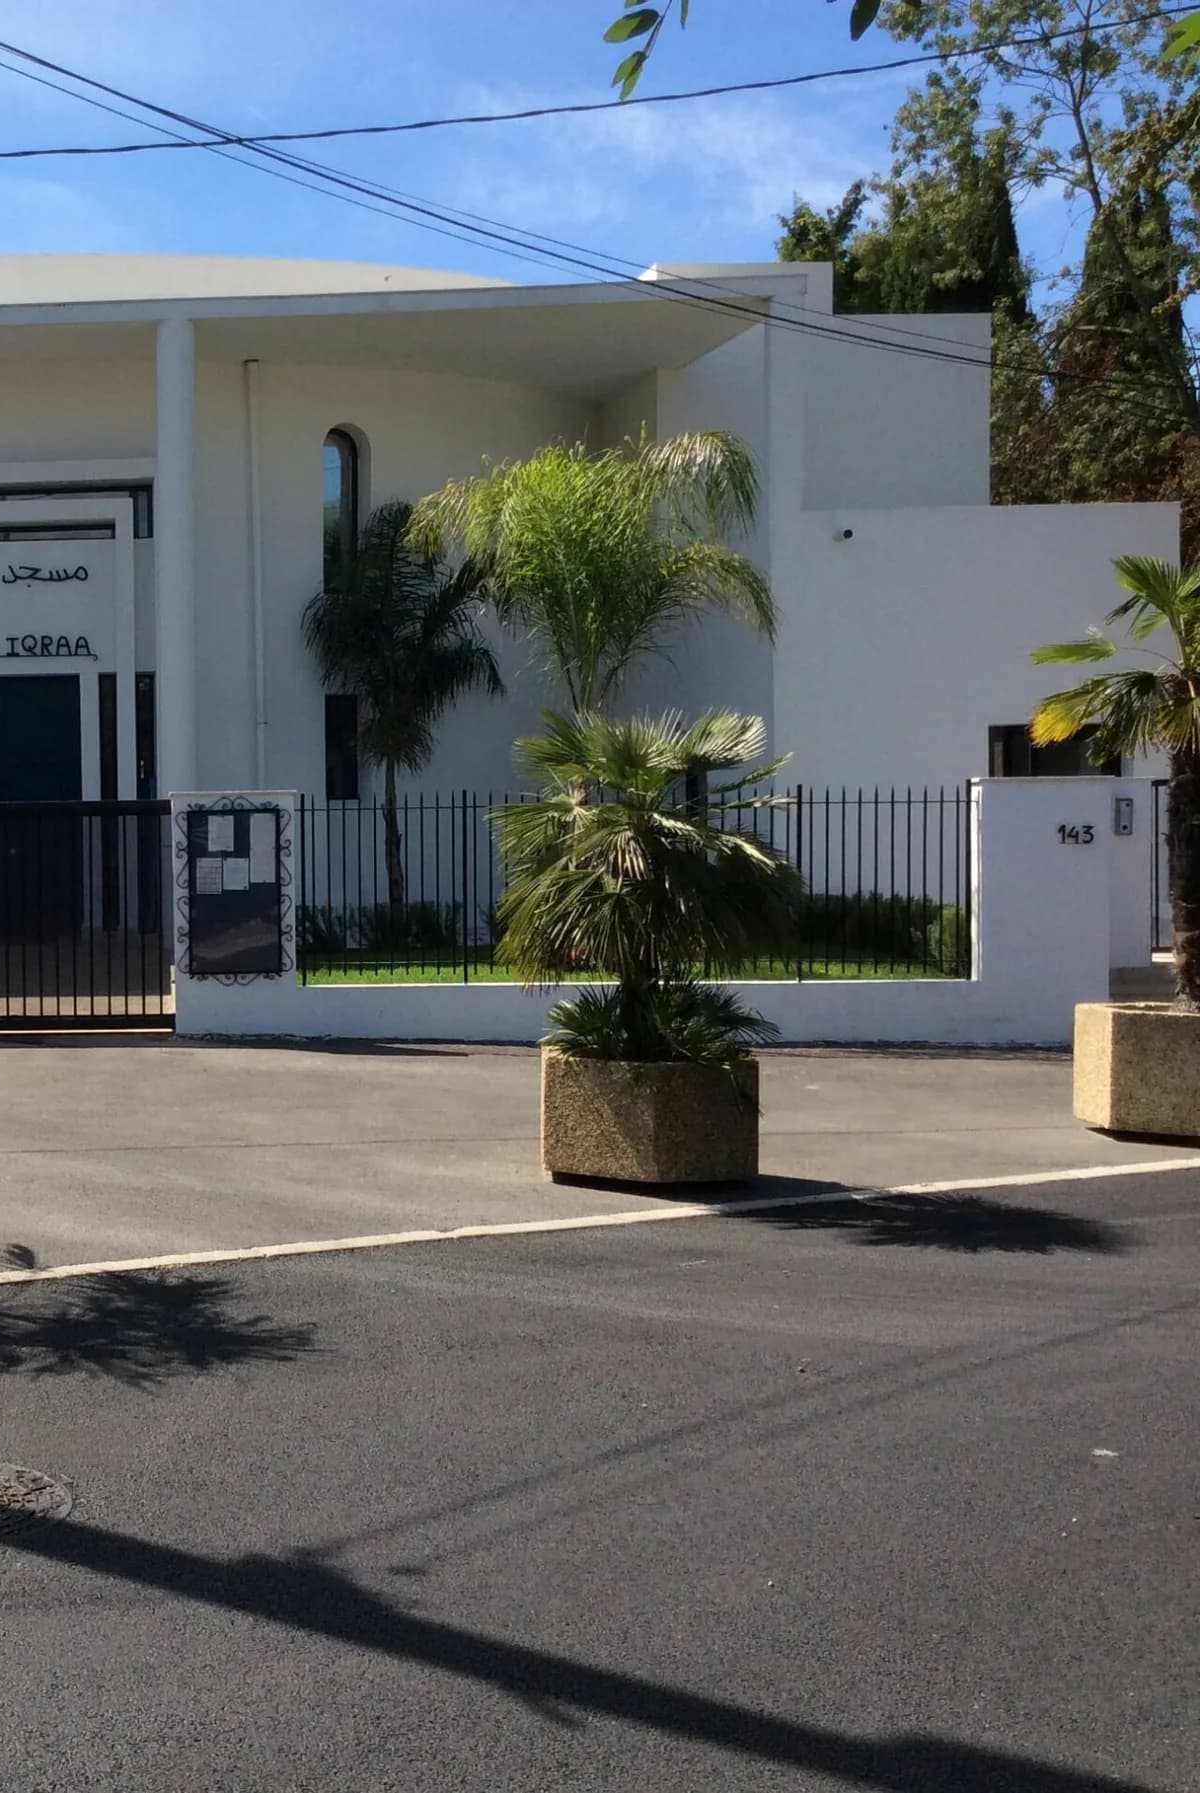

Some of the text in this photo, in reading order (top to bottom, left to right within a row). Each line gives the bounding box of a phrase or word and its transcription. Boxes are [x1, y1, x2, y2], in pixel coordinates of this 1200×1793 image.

[2, 565, 89, 588] مسجد
[5, 634, 92, 657] IQRAA
[1057, 824, 1095, 844] 143
